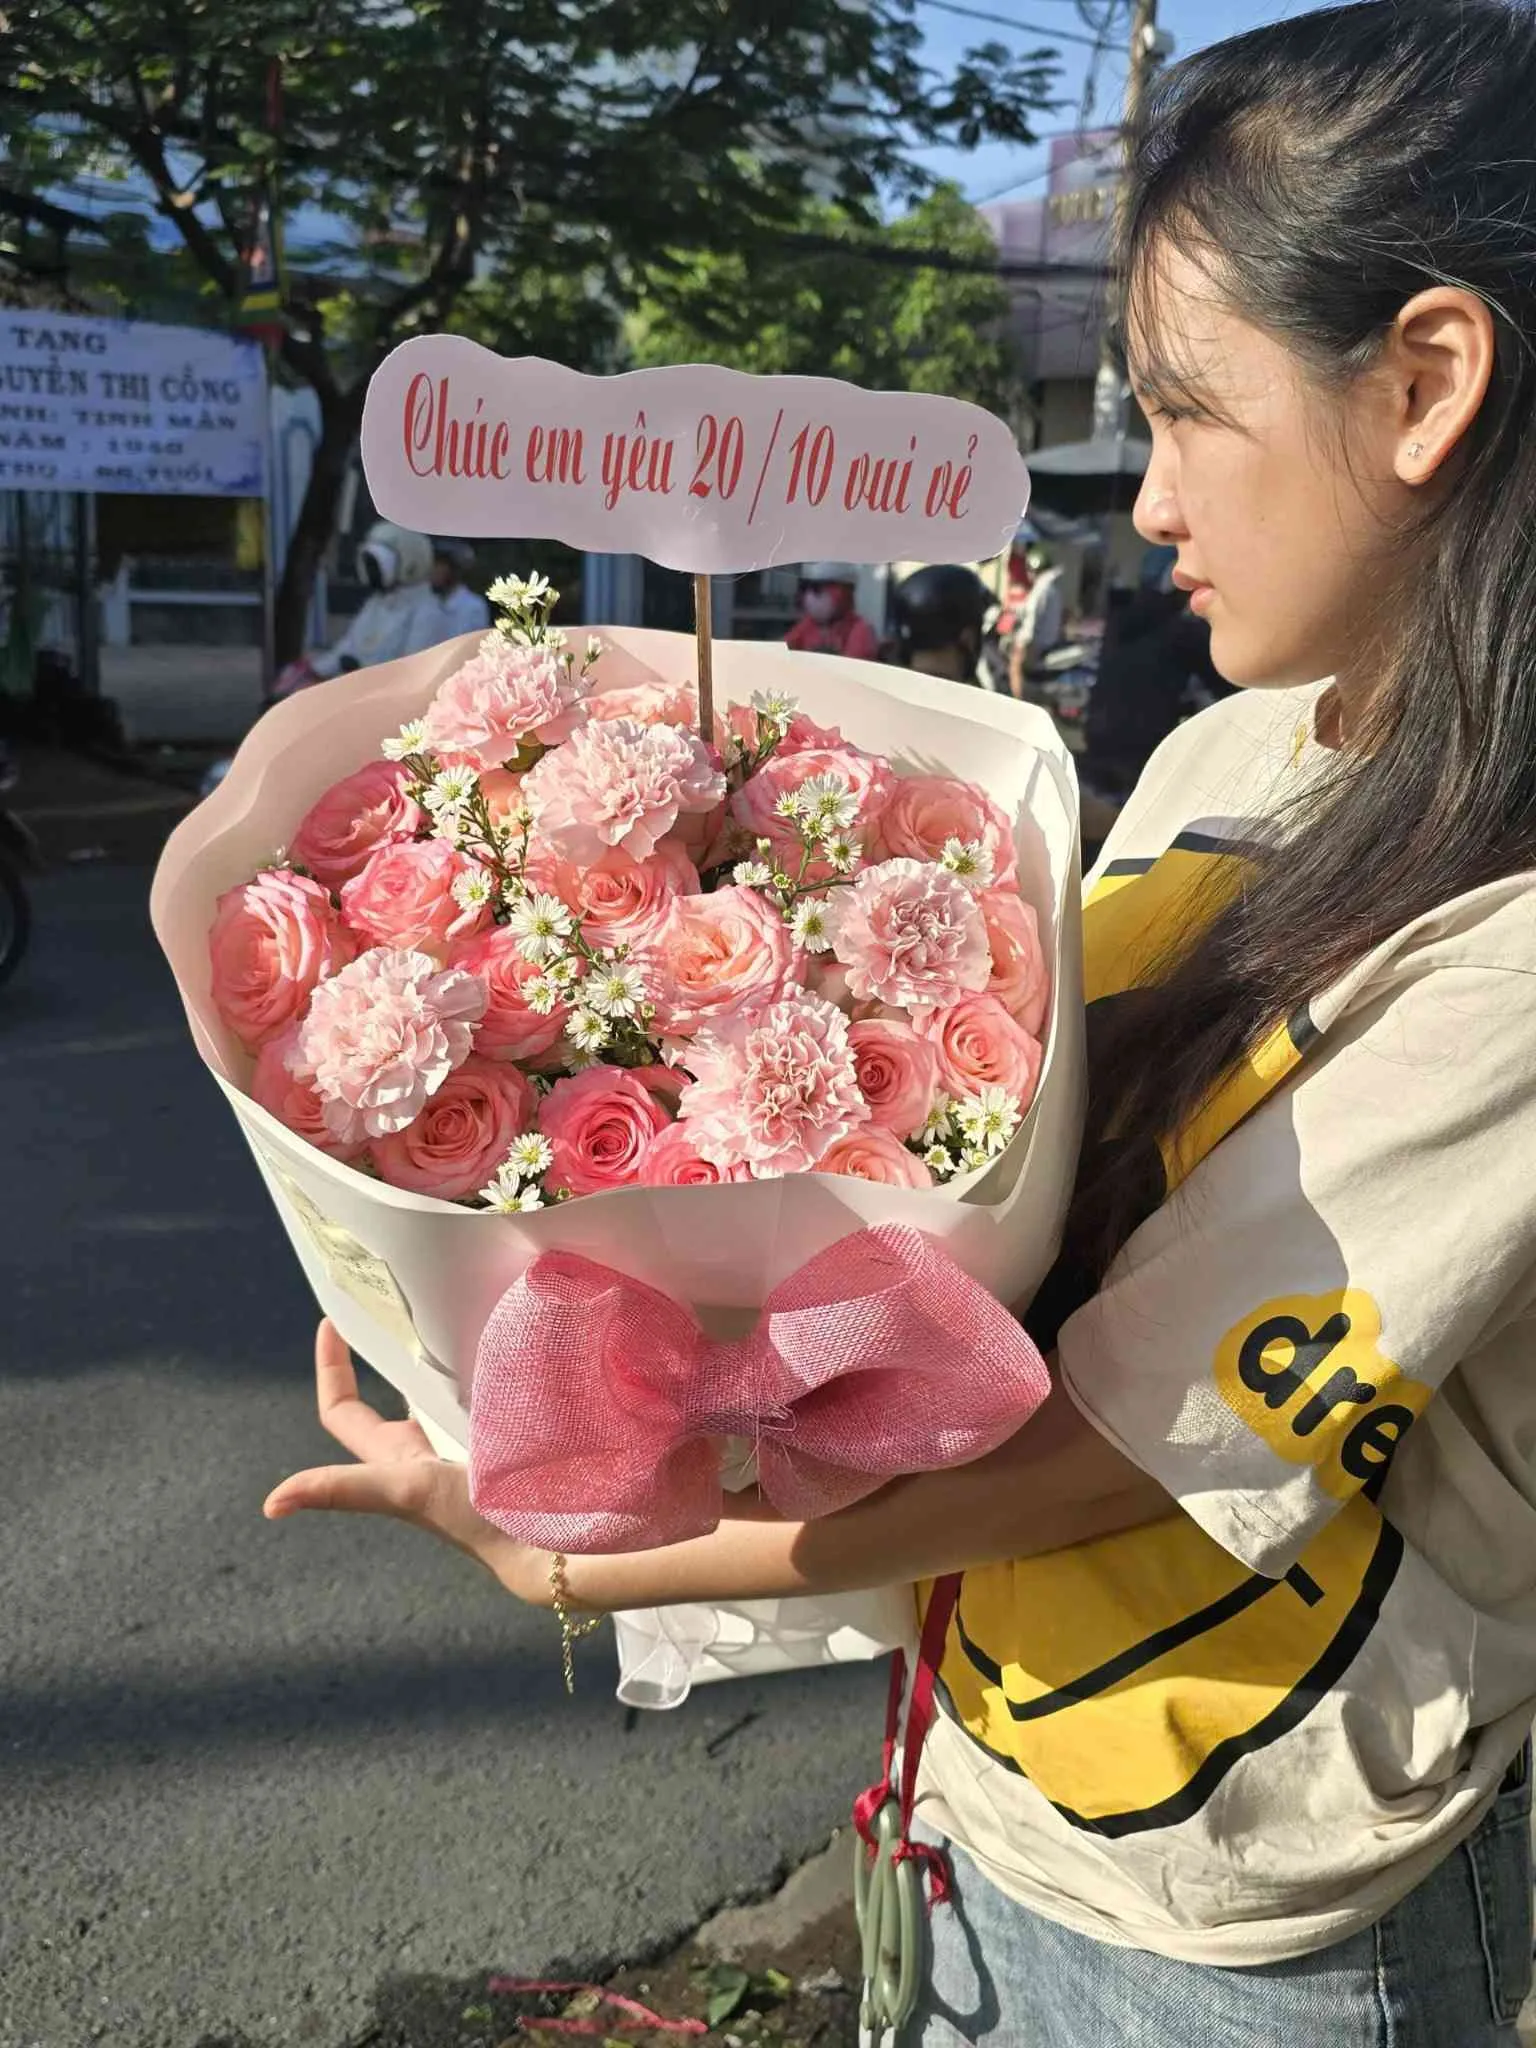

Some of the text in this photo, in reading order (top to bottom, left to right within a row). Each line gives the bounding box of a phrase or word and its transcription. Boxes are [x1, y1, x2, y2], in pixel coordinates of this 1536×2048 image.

[403, 372, 511, 480] Chúc
[526, 425, 586, 485] em
[602, 410, 676, 511] yêu
[844, 435, 916, 513] vui
[925, 434, 978, 519] vẻ
